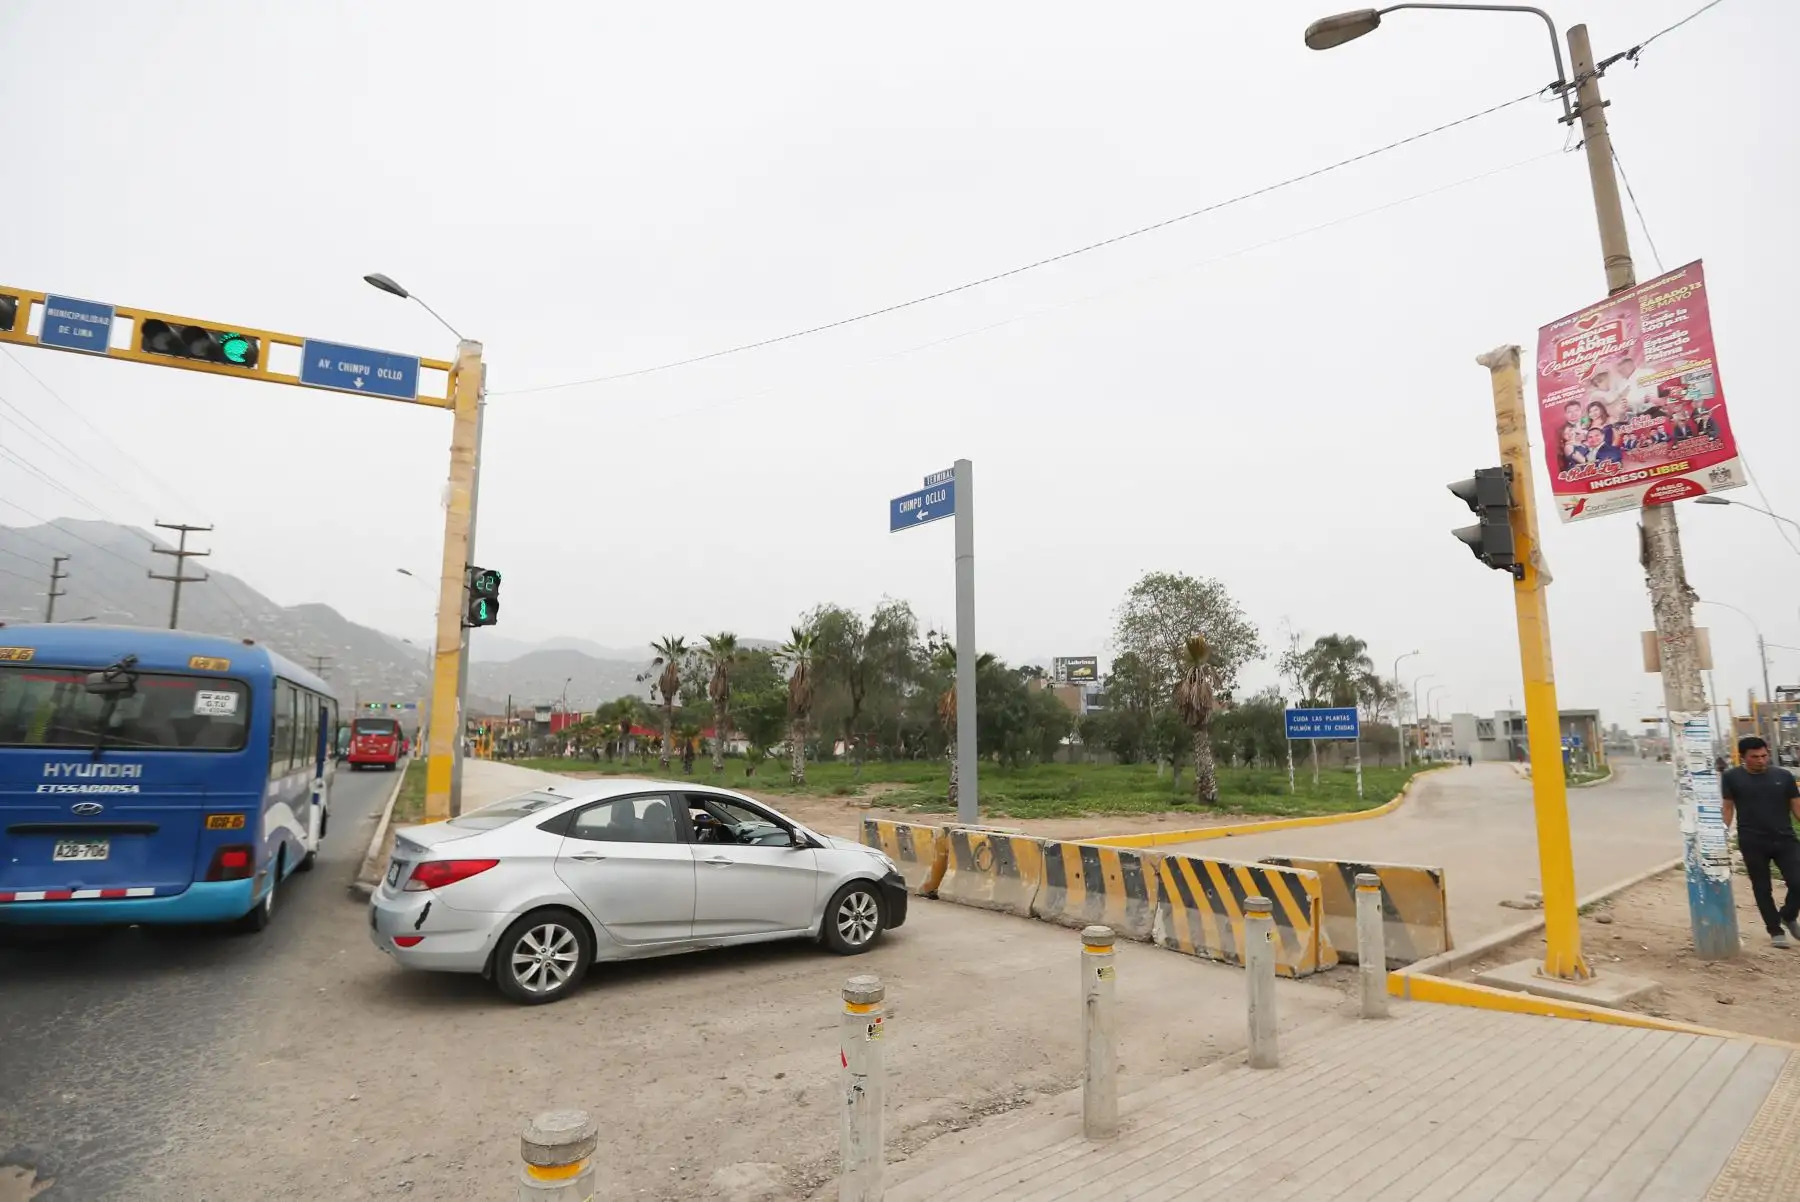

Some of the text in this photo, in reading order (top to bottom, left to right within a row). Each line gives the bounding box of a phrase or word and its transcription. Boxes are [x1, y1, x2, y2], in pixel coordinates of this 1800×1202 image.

[48, 308, 110, 326] MUNICIPALIDAD
[59, 325, 93, 337] DE LIMA
[1562, 334, 1618, 359] MADRE
[318, 358, 333, 369] AV.
[377, 368, 403, 380] OCLLO
[1590, 461, 1690, 490] INGRESO LIBRE
[1651, 486, 1692, 498] MENDOZA
[1656, 483, 1683, 493] PABLO
[925, 489, 946, 506] OCLLO
[476, 575, 494, 591] 22
[43, 762, 143, 778] HYUNDAI
